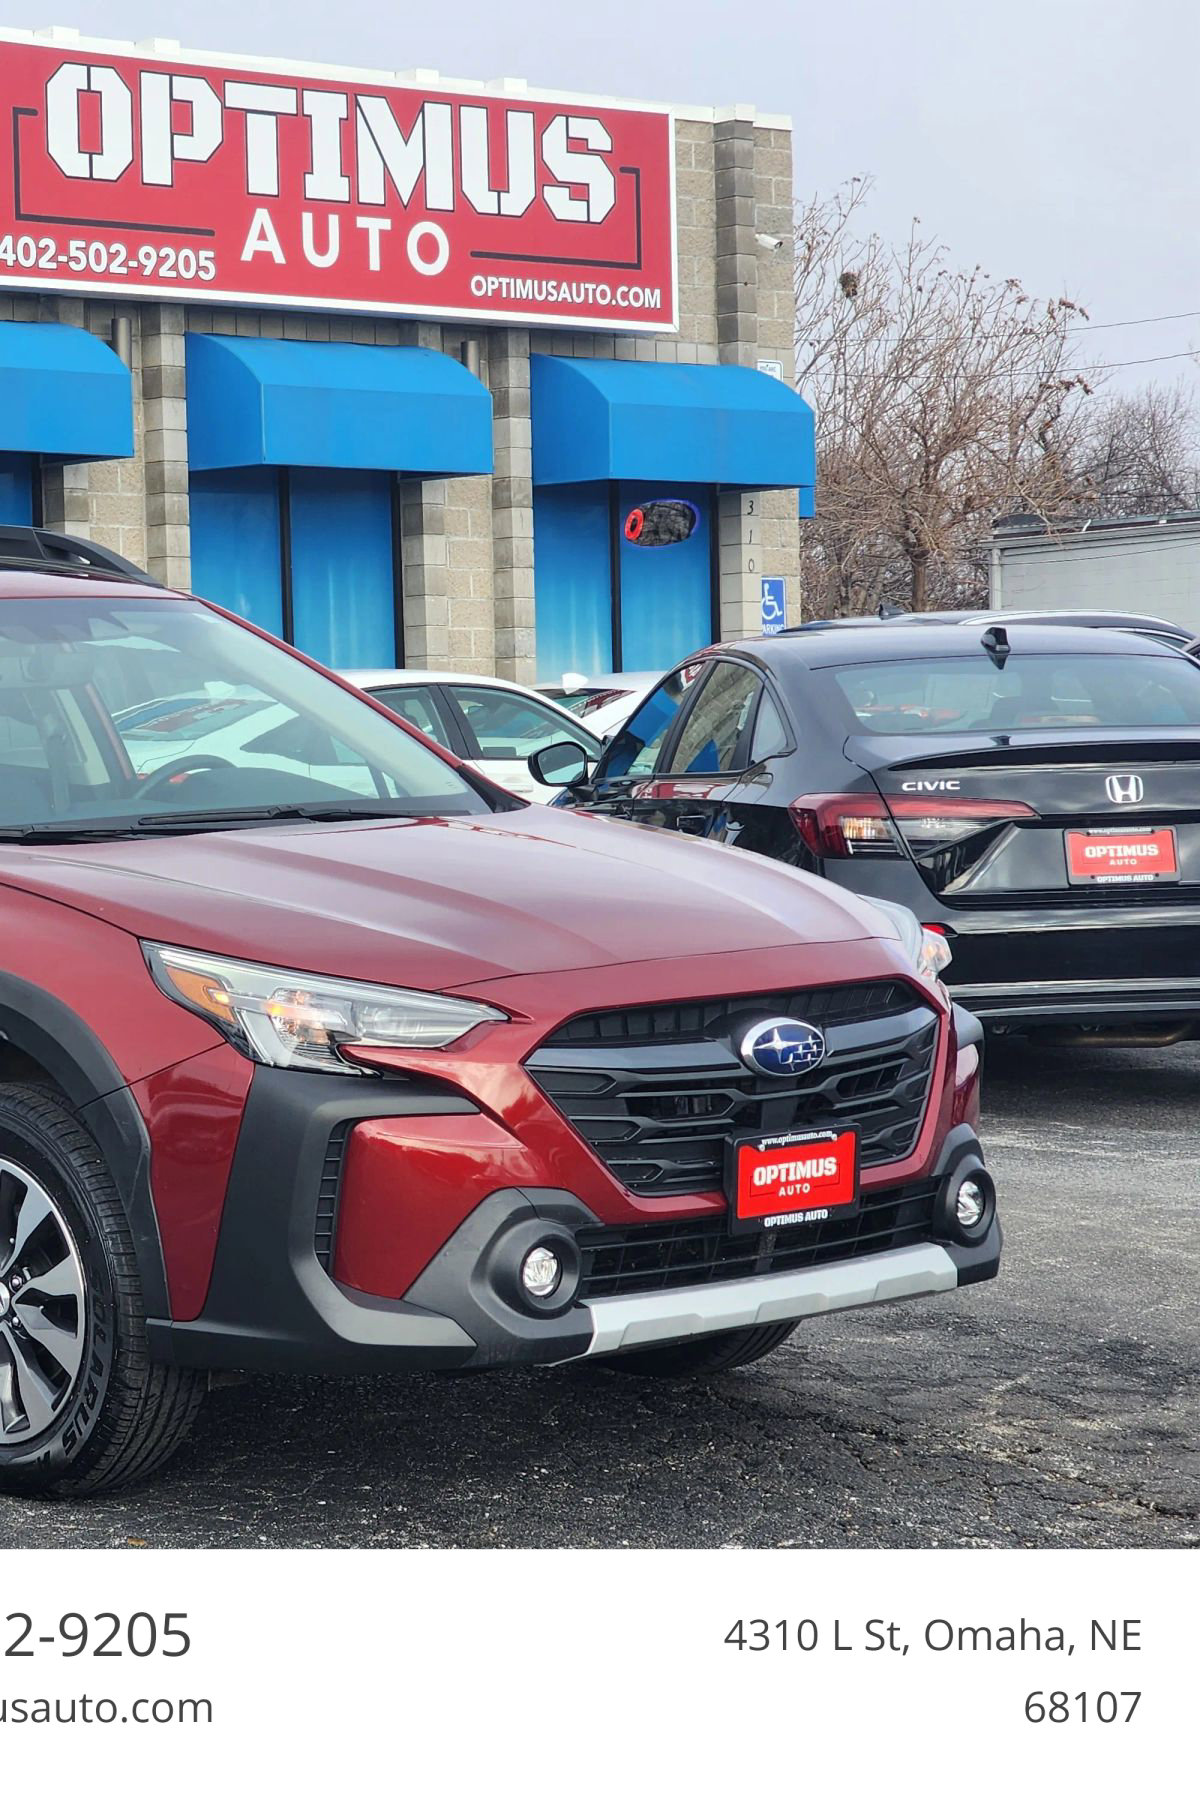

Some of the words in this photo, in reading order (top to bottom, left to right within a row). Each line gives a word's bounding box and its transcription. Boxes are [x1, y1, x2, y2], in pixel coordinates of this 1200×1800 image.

[45, 61, 616, 224] OPTIMUS
[240, 207, 450, 276] AUTO
[470, 275, 662, 310] OPTIMUSAUTO.COM
[902, 780, 960, 791] CIVIC
[1085, 844, 1159, 858] OPTIMUS
[1109, 858, 1138, 866] AUTO
[1097, 875, 1132, 883] OPTIMUS
[753, 1157, 837, 1186] OPTIMUS
[778, 1183, 811, 1197] AUTO
[764, 1212, 804, 1227] OPTIMUS
[805, 1209, 828, 1222] AUTO
